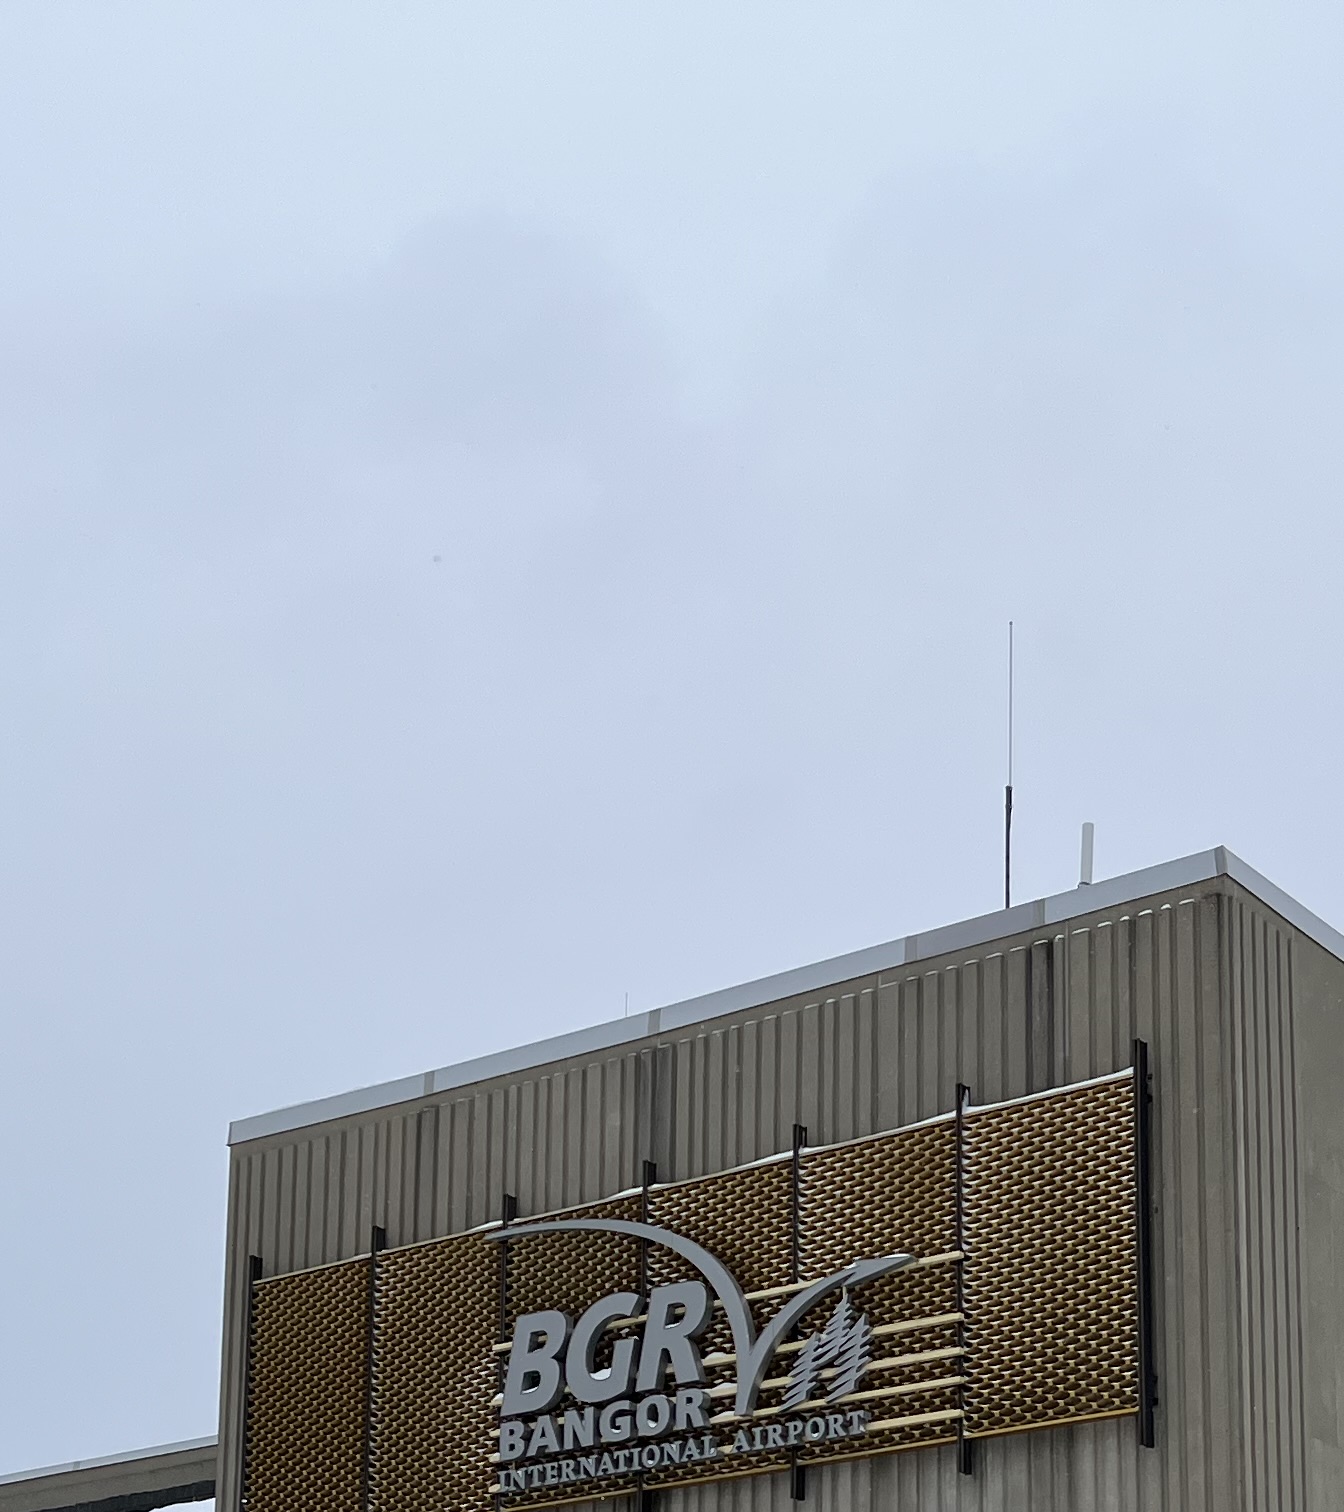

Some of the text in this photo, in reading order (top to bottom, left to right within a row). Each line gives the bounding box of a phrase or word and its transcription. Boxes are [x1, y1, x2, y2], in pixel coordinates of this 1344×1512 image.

[500, 1281, 713, 1416] BGR
[498, 1411, 867, 1493] INTERNATIONAL AIRPORT
[499, 1389, 711, 1461] BANGOR
